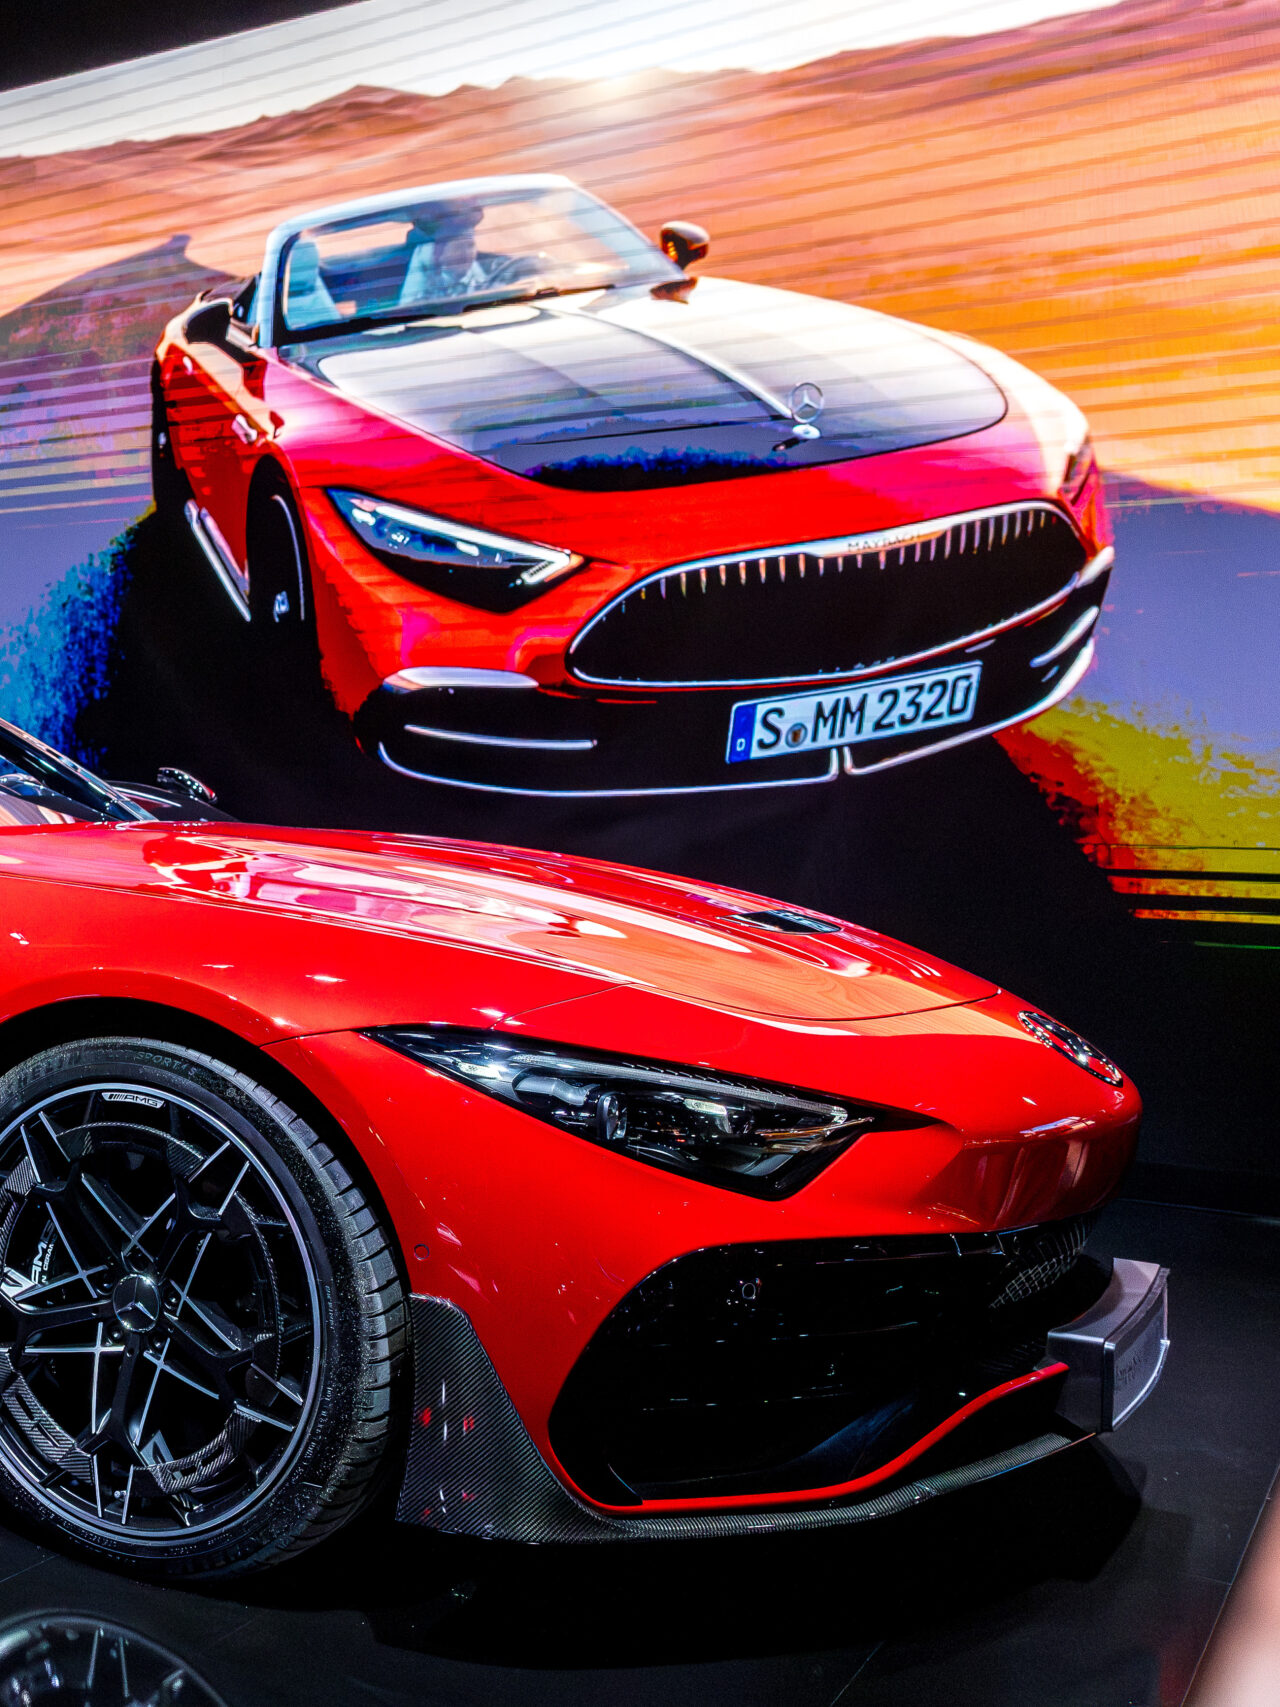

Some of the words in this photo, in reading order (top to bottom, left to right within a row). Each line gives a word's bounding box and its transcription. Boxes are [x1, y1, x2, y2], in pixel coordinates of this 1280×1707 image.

[757, 707, 785, 749] S
[811, 692, 868, 742] MM
[872, 674, 973, 732] 2320
[124, 1094, 158, 1107] AMG
